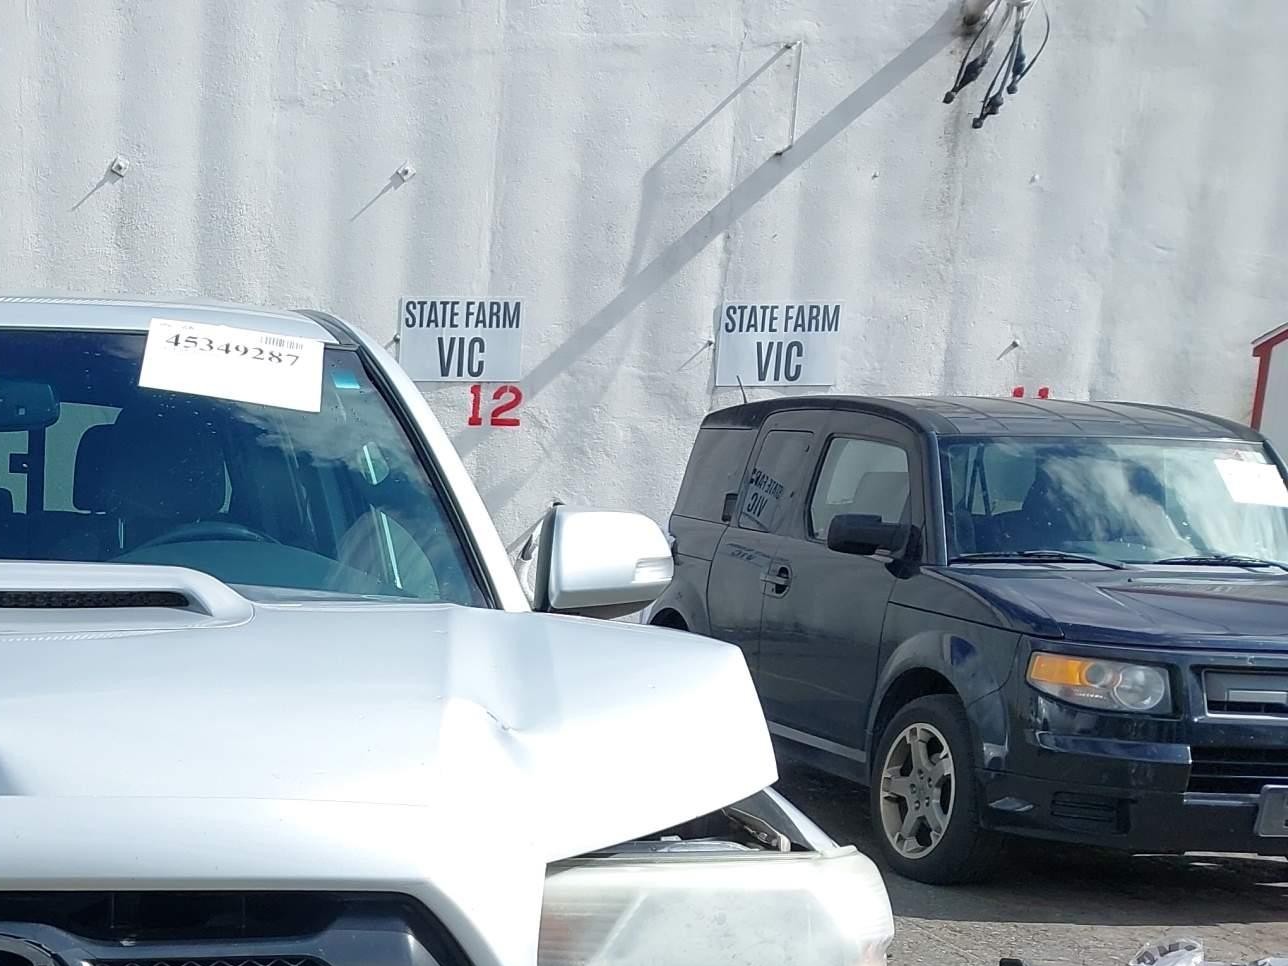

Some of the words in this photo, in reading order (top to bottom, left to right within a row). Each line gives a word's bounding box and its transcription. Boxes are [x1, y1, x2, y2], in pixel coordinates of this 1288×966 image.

[404, 300, 460, 329] STATE
[464, 300, 521, 329] FARM
[724, 304, 779, 333] STATE
[783, 304, 841, 333] FARM
[165, 333, 300, 367] 45349287
[437, 336, 485, 378] VIC
[756, 340, 804, 382] VIC
[467, 384, 523, 427] 12
